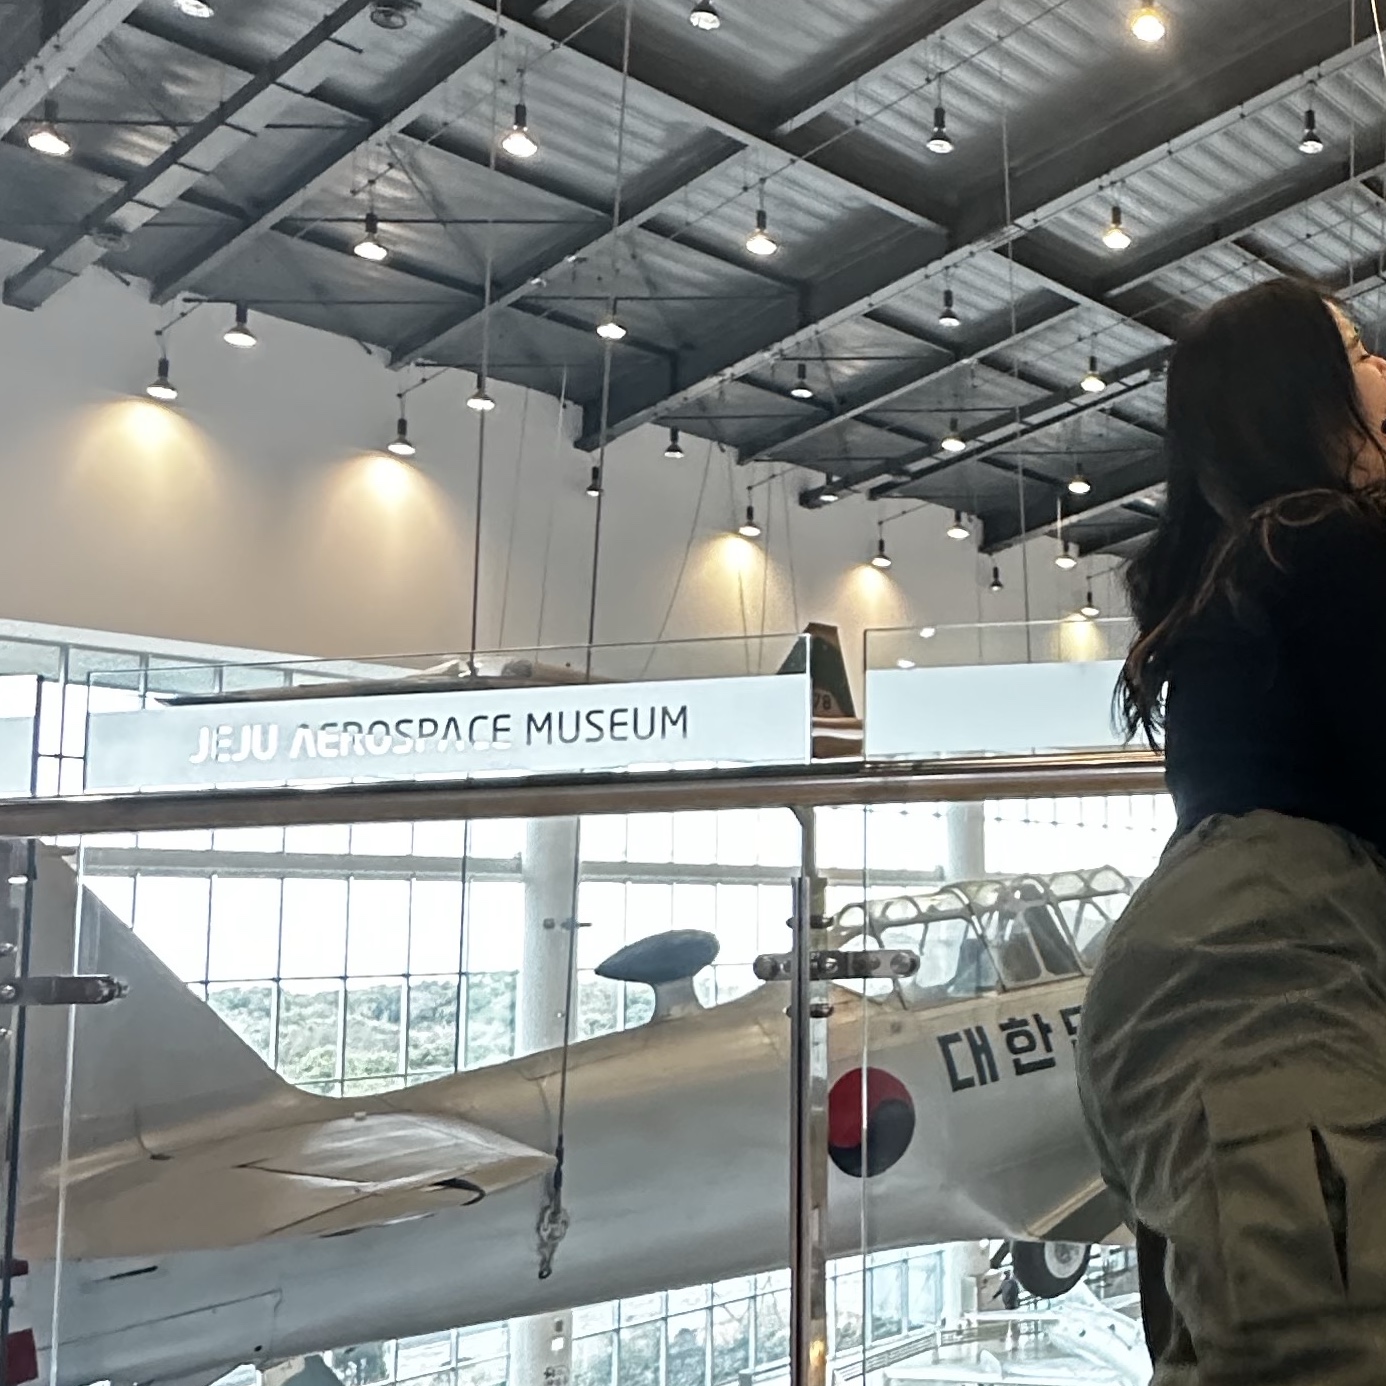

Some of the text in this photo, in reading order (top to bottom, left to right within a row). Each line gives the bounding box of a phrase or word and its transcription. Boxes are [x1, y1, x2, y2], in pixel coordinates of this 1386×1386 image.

[189, 705, 688, 764] JEJU AEROSPACE MUSEUM
